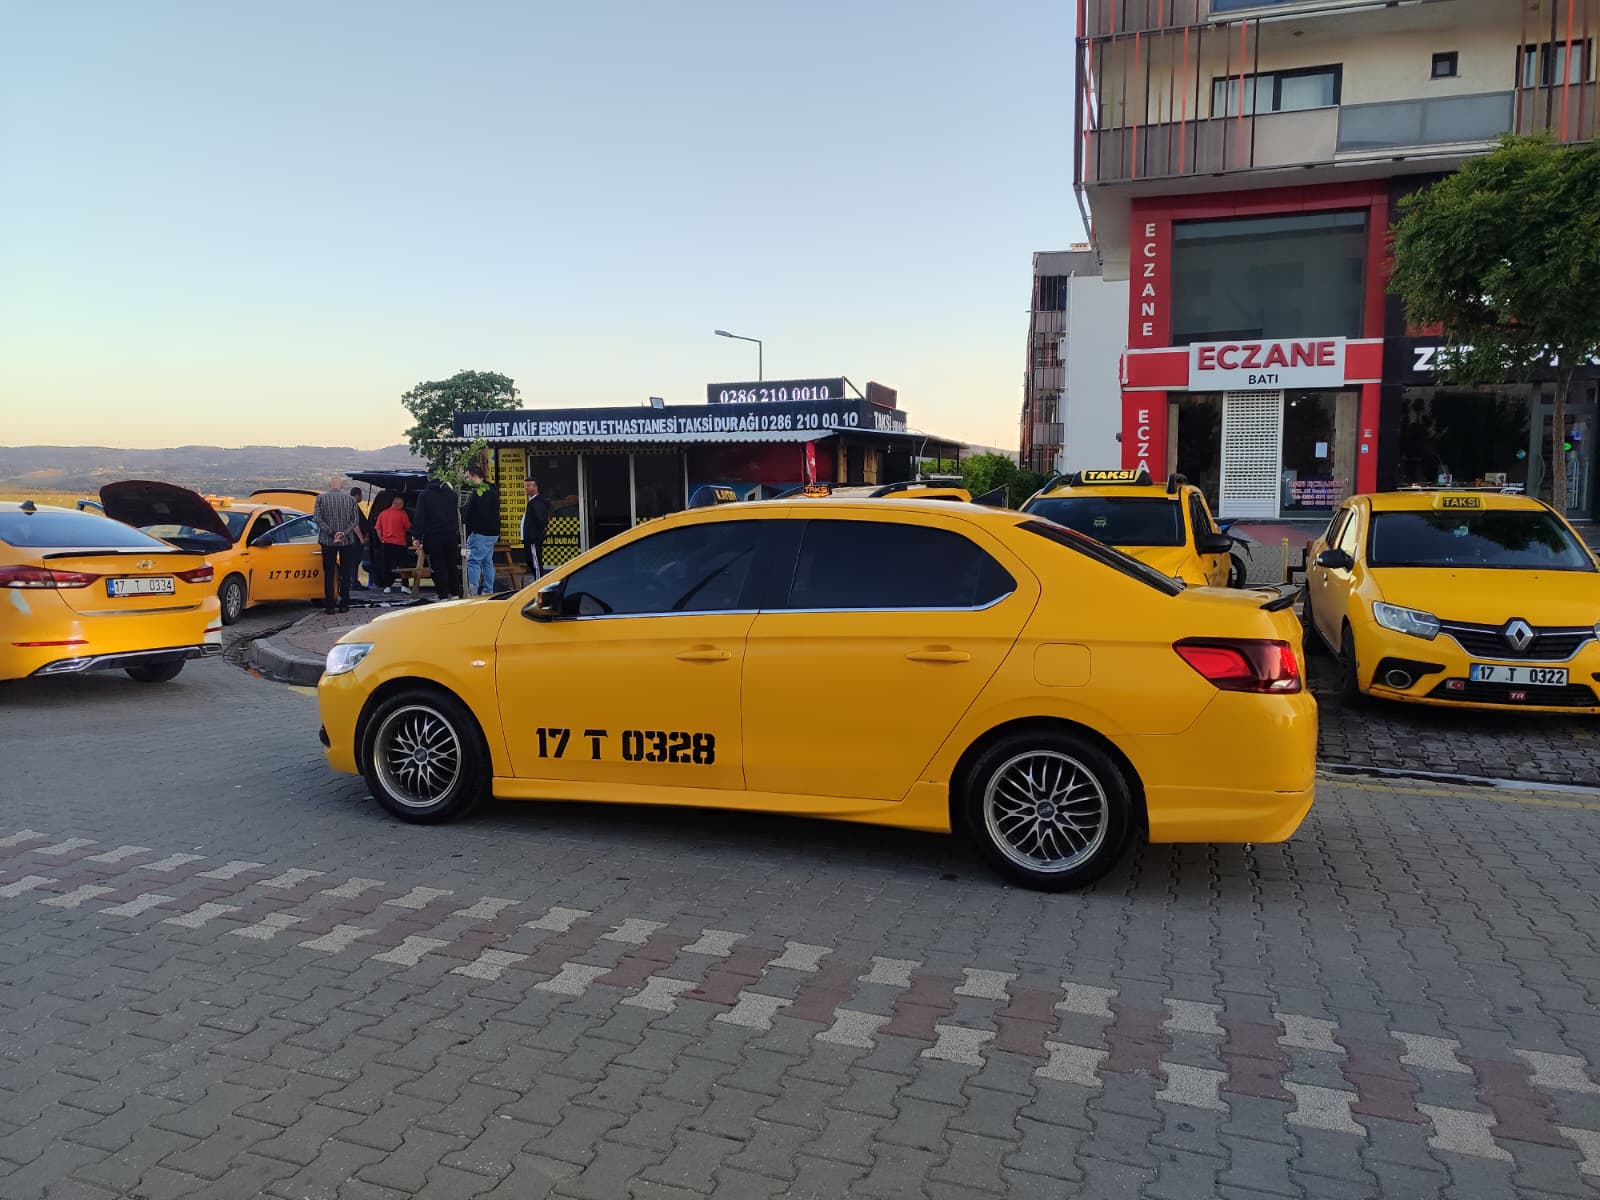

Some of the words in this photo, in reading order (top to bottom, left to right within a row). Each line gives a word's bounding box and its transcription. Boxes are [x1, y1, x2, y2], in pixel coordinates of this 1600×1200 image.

[1141, 223, 1157, 336] ECZANE
[1198, 341, 1336, 370] ECZANE
[1248, 374, 1279, 385] BATI
[720, 389, 756, 403] 0286
[760, 388, 787, 402] 210
[792, 386, 829, 401] 0010
[463, 422, 510, 437] MEHMET
[512, 419, 537, 436] AKİF
[539, 421, 572, 435] ERSOY
[679, 414, 712, 432] TAKSİ
[714, 412, 759, 431] DURAĞI
[761, 414, 792, 430] 0286
[797, 413, 819, 429] 210
[269, 570, 281, 579] 17
[284, 569, 291, 579] T
[115, 580, 125, 592] 17
[134, 579, 140, 592] T
[150, 579, 172, 591] 0334
[1480, 666, 1495, 680] 17
[1508, 667, 1517, 681] T
[1529, 669, 1565, 684] 0322
[536, 727, 571, 758] 17
[584, 729, 608, 760] T
[622, 730, 716, 765] 0328
